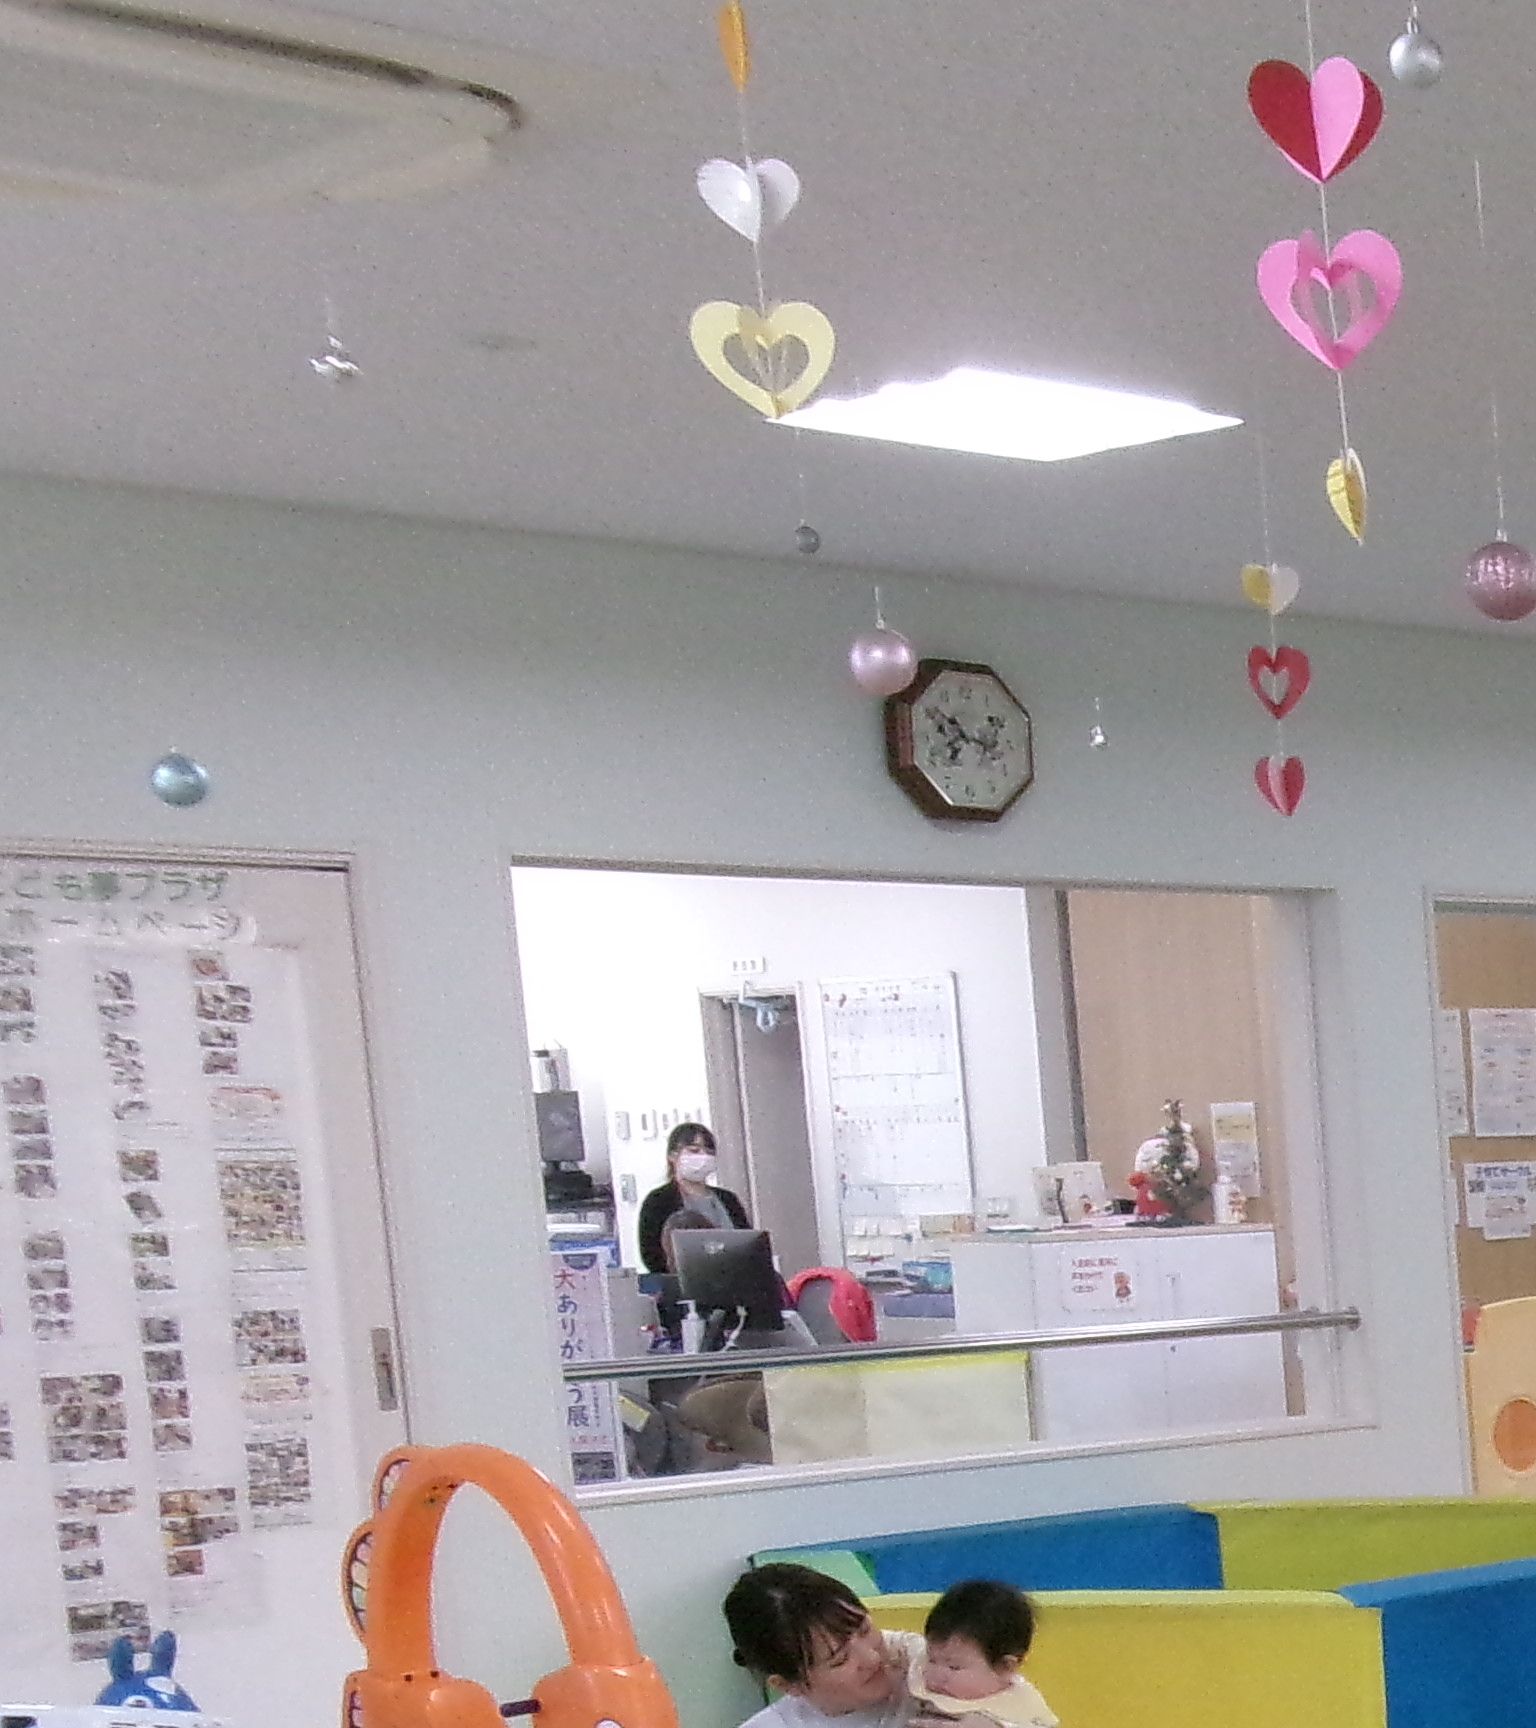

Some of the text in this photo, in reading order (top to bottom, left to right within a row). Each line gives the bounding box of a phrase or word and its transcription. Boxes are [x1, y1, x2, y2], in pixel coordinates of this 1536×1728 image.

[553, 1269, 591, 1428] 大ありがう展
